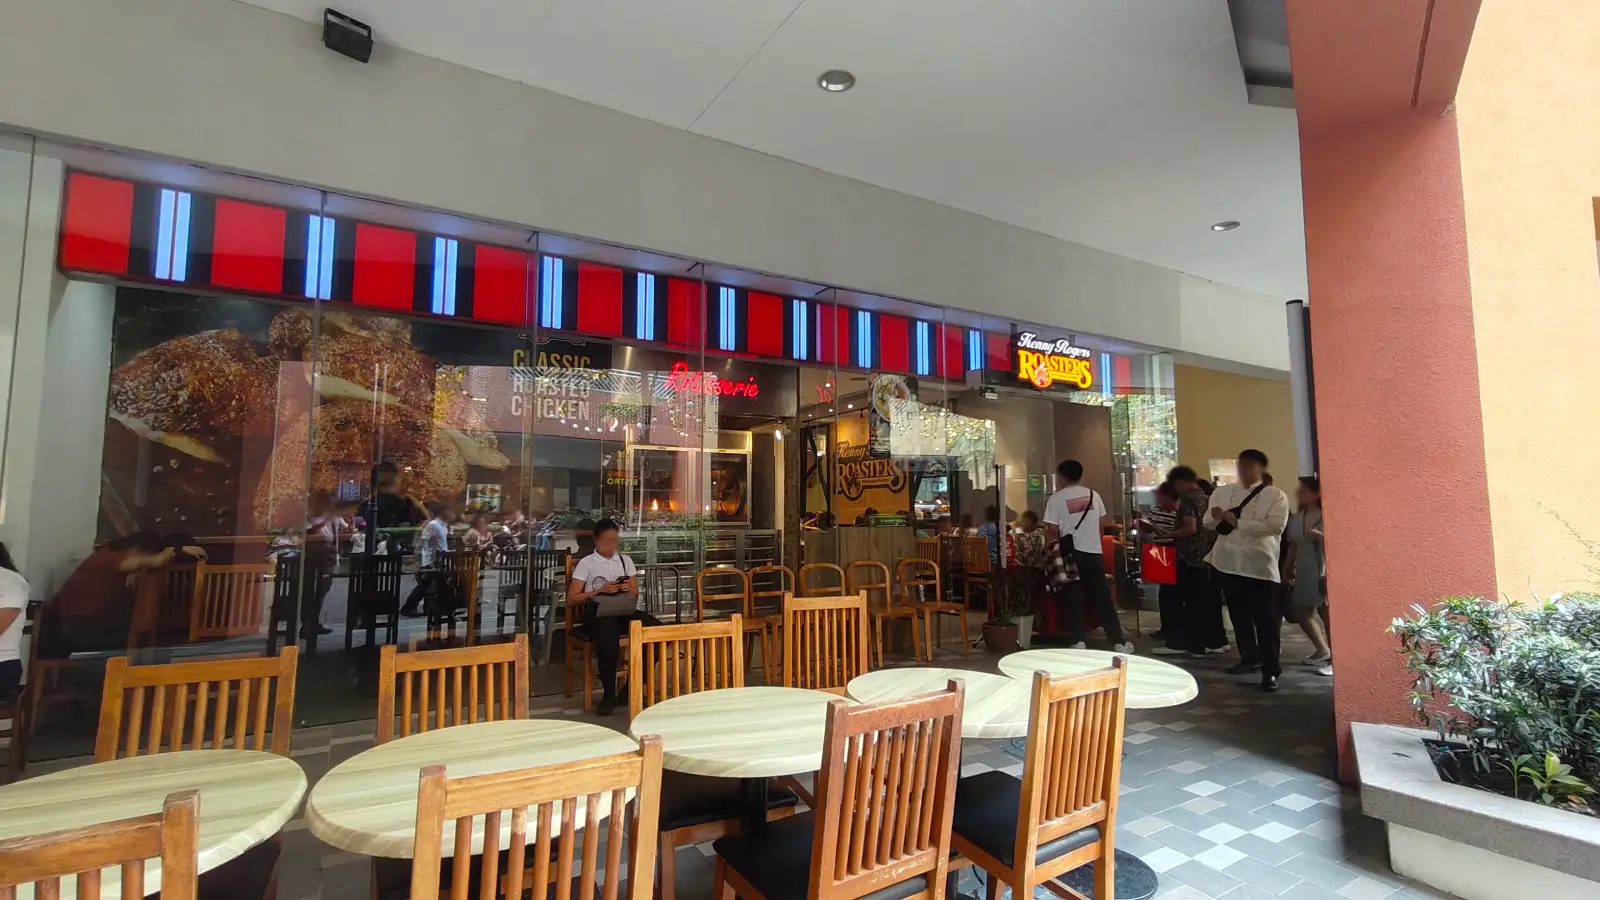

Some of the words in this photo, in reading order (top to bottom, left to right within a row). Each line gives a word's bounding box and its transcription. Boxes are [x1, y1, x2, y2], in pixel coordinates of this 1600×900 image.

[1017, 332, 1055, 355] Kenny
[1054, 339, 1091, 359] Rogers
[512, 348, 591, 374] CLASSIC
[1017, 349, 1093, 389] ROASTERS
[664, 361, 759, 398] Rotisserie
[511, 395, 590, 421] CHICKEN
[837, 443, 866, 460] Kenny
